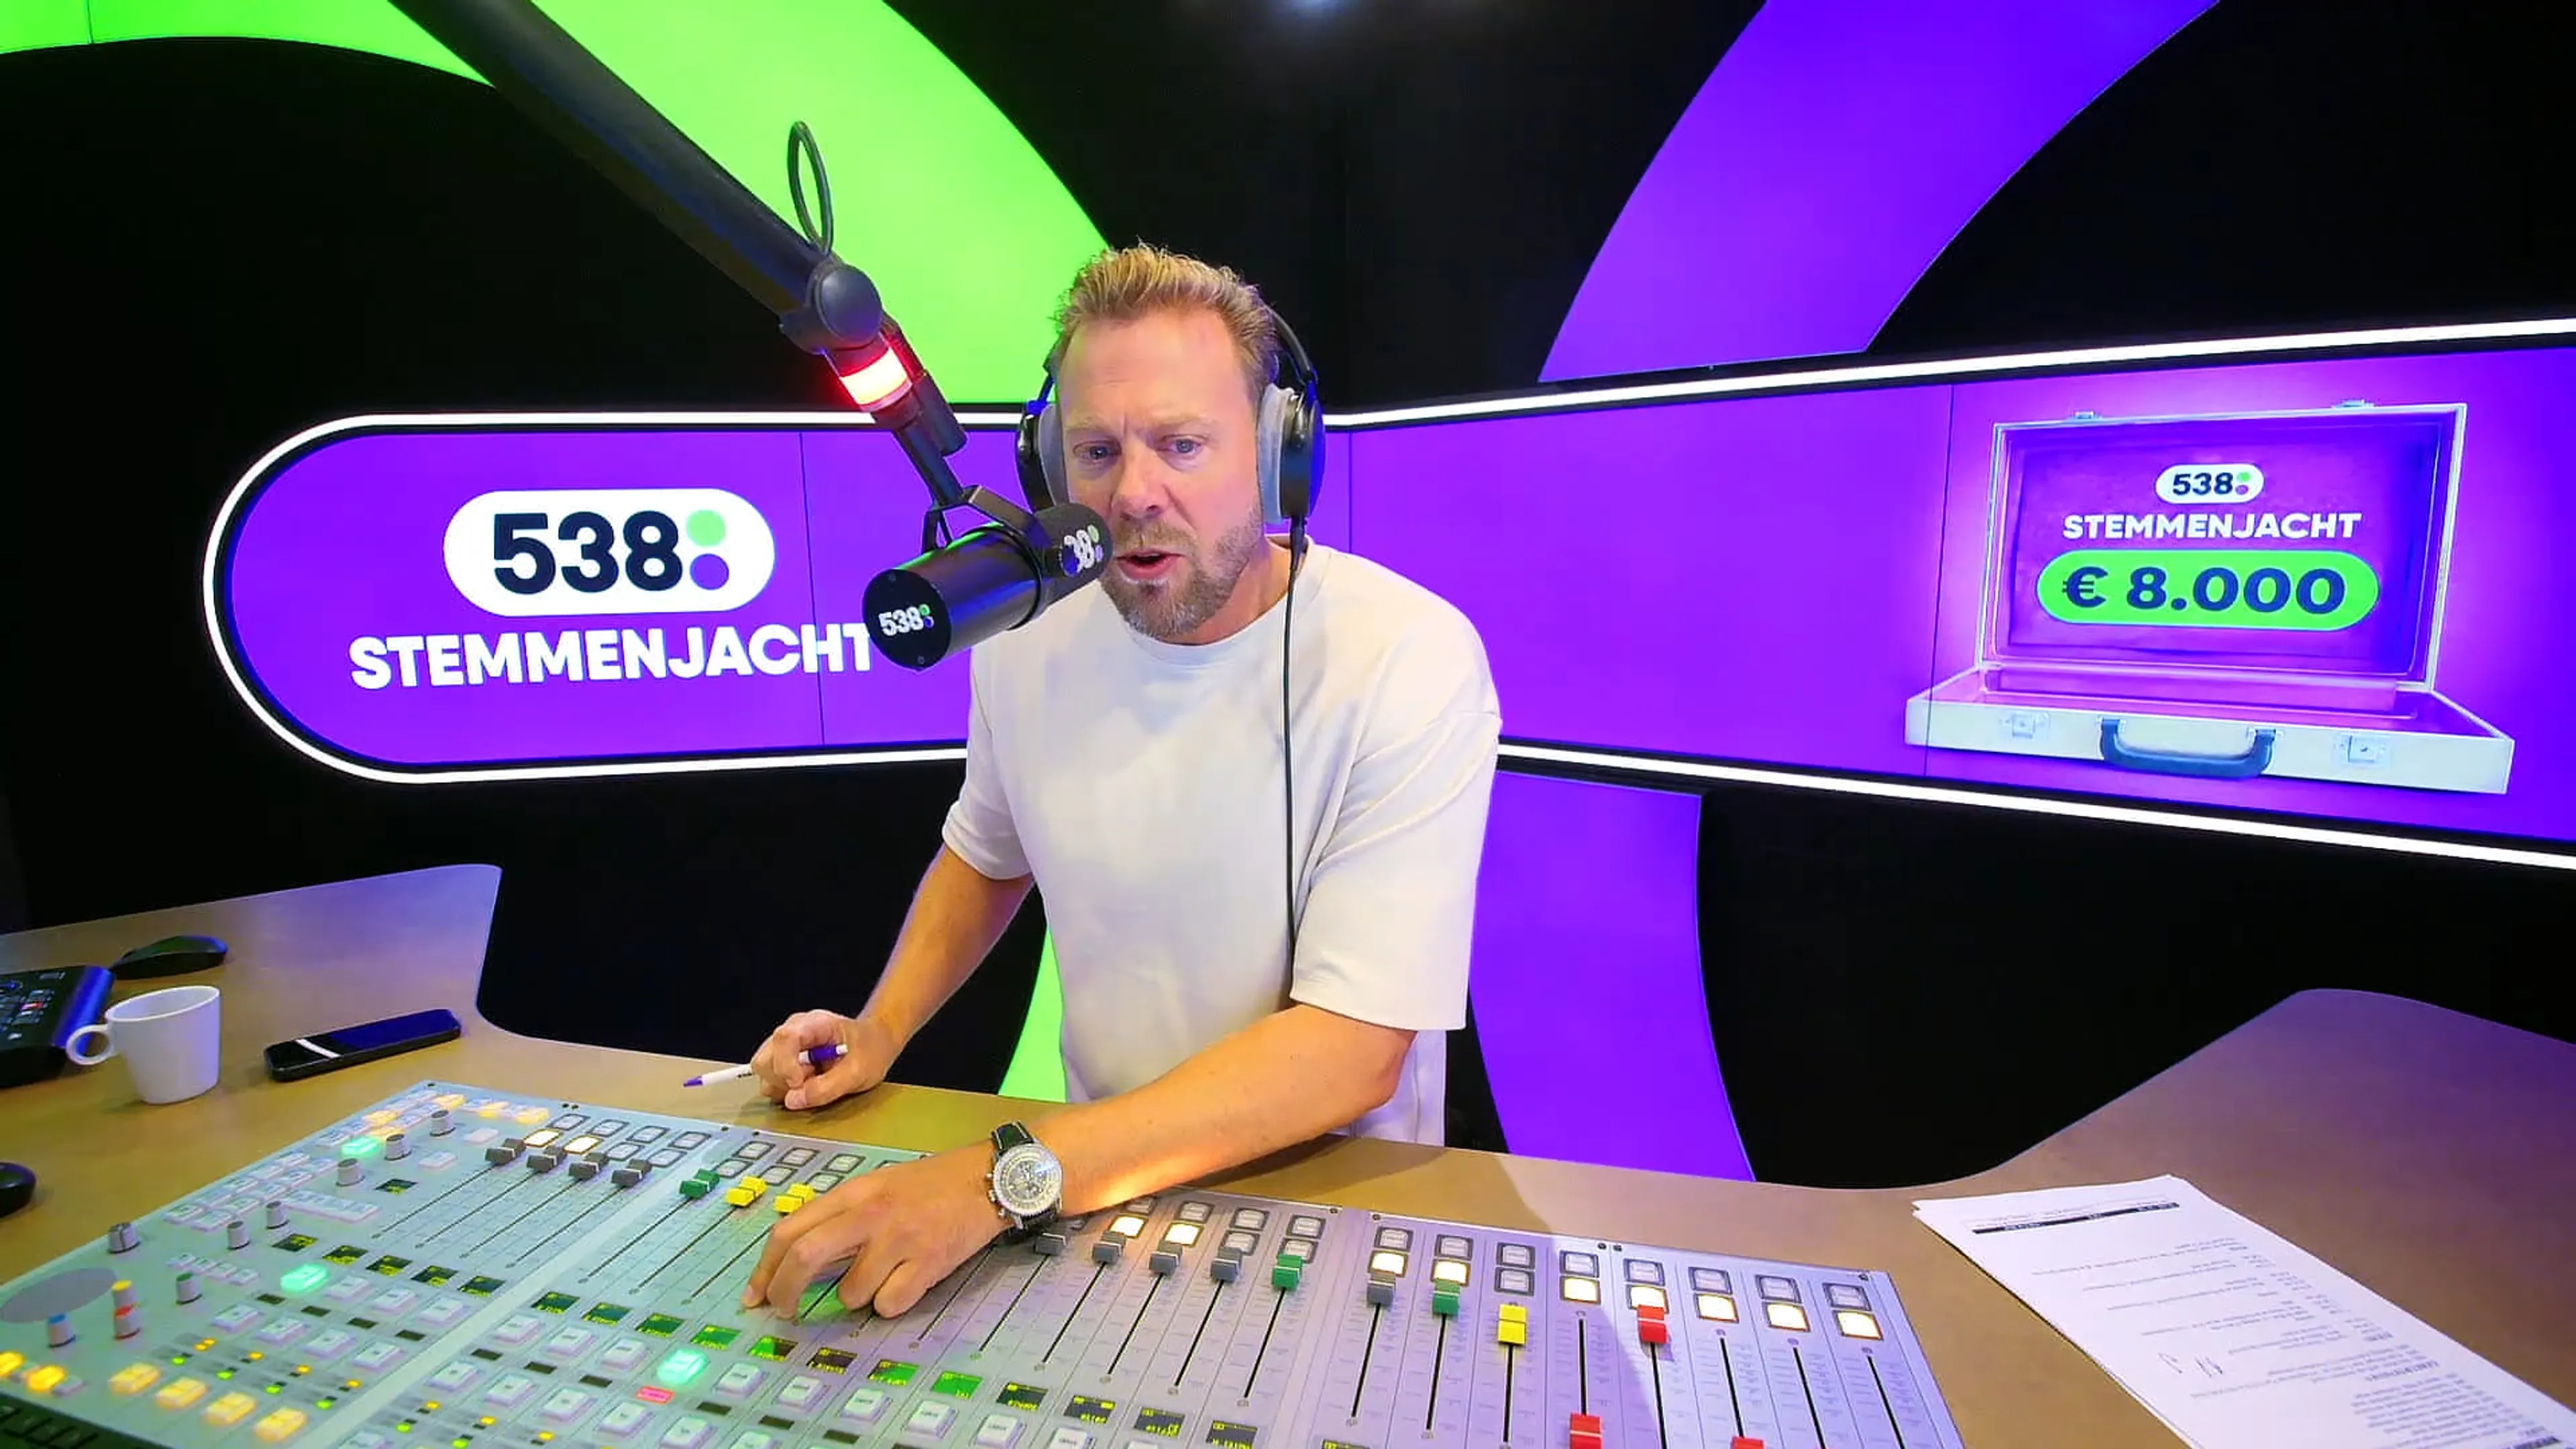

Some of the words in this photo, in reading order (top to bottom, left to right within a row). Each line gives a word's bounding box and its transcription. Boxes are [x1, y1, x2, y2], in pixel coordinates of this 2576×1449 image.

[2062, 512, 2362, 539] STEMMENJACHT
[2061, 566, 2108, 608] €
[2126, 566, 2346, 614] 8.000
[349, 621, 871, 690] STEMMENJACHT
